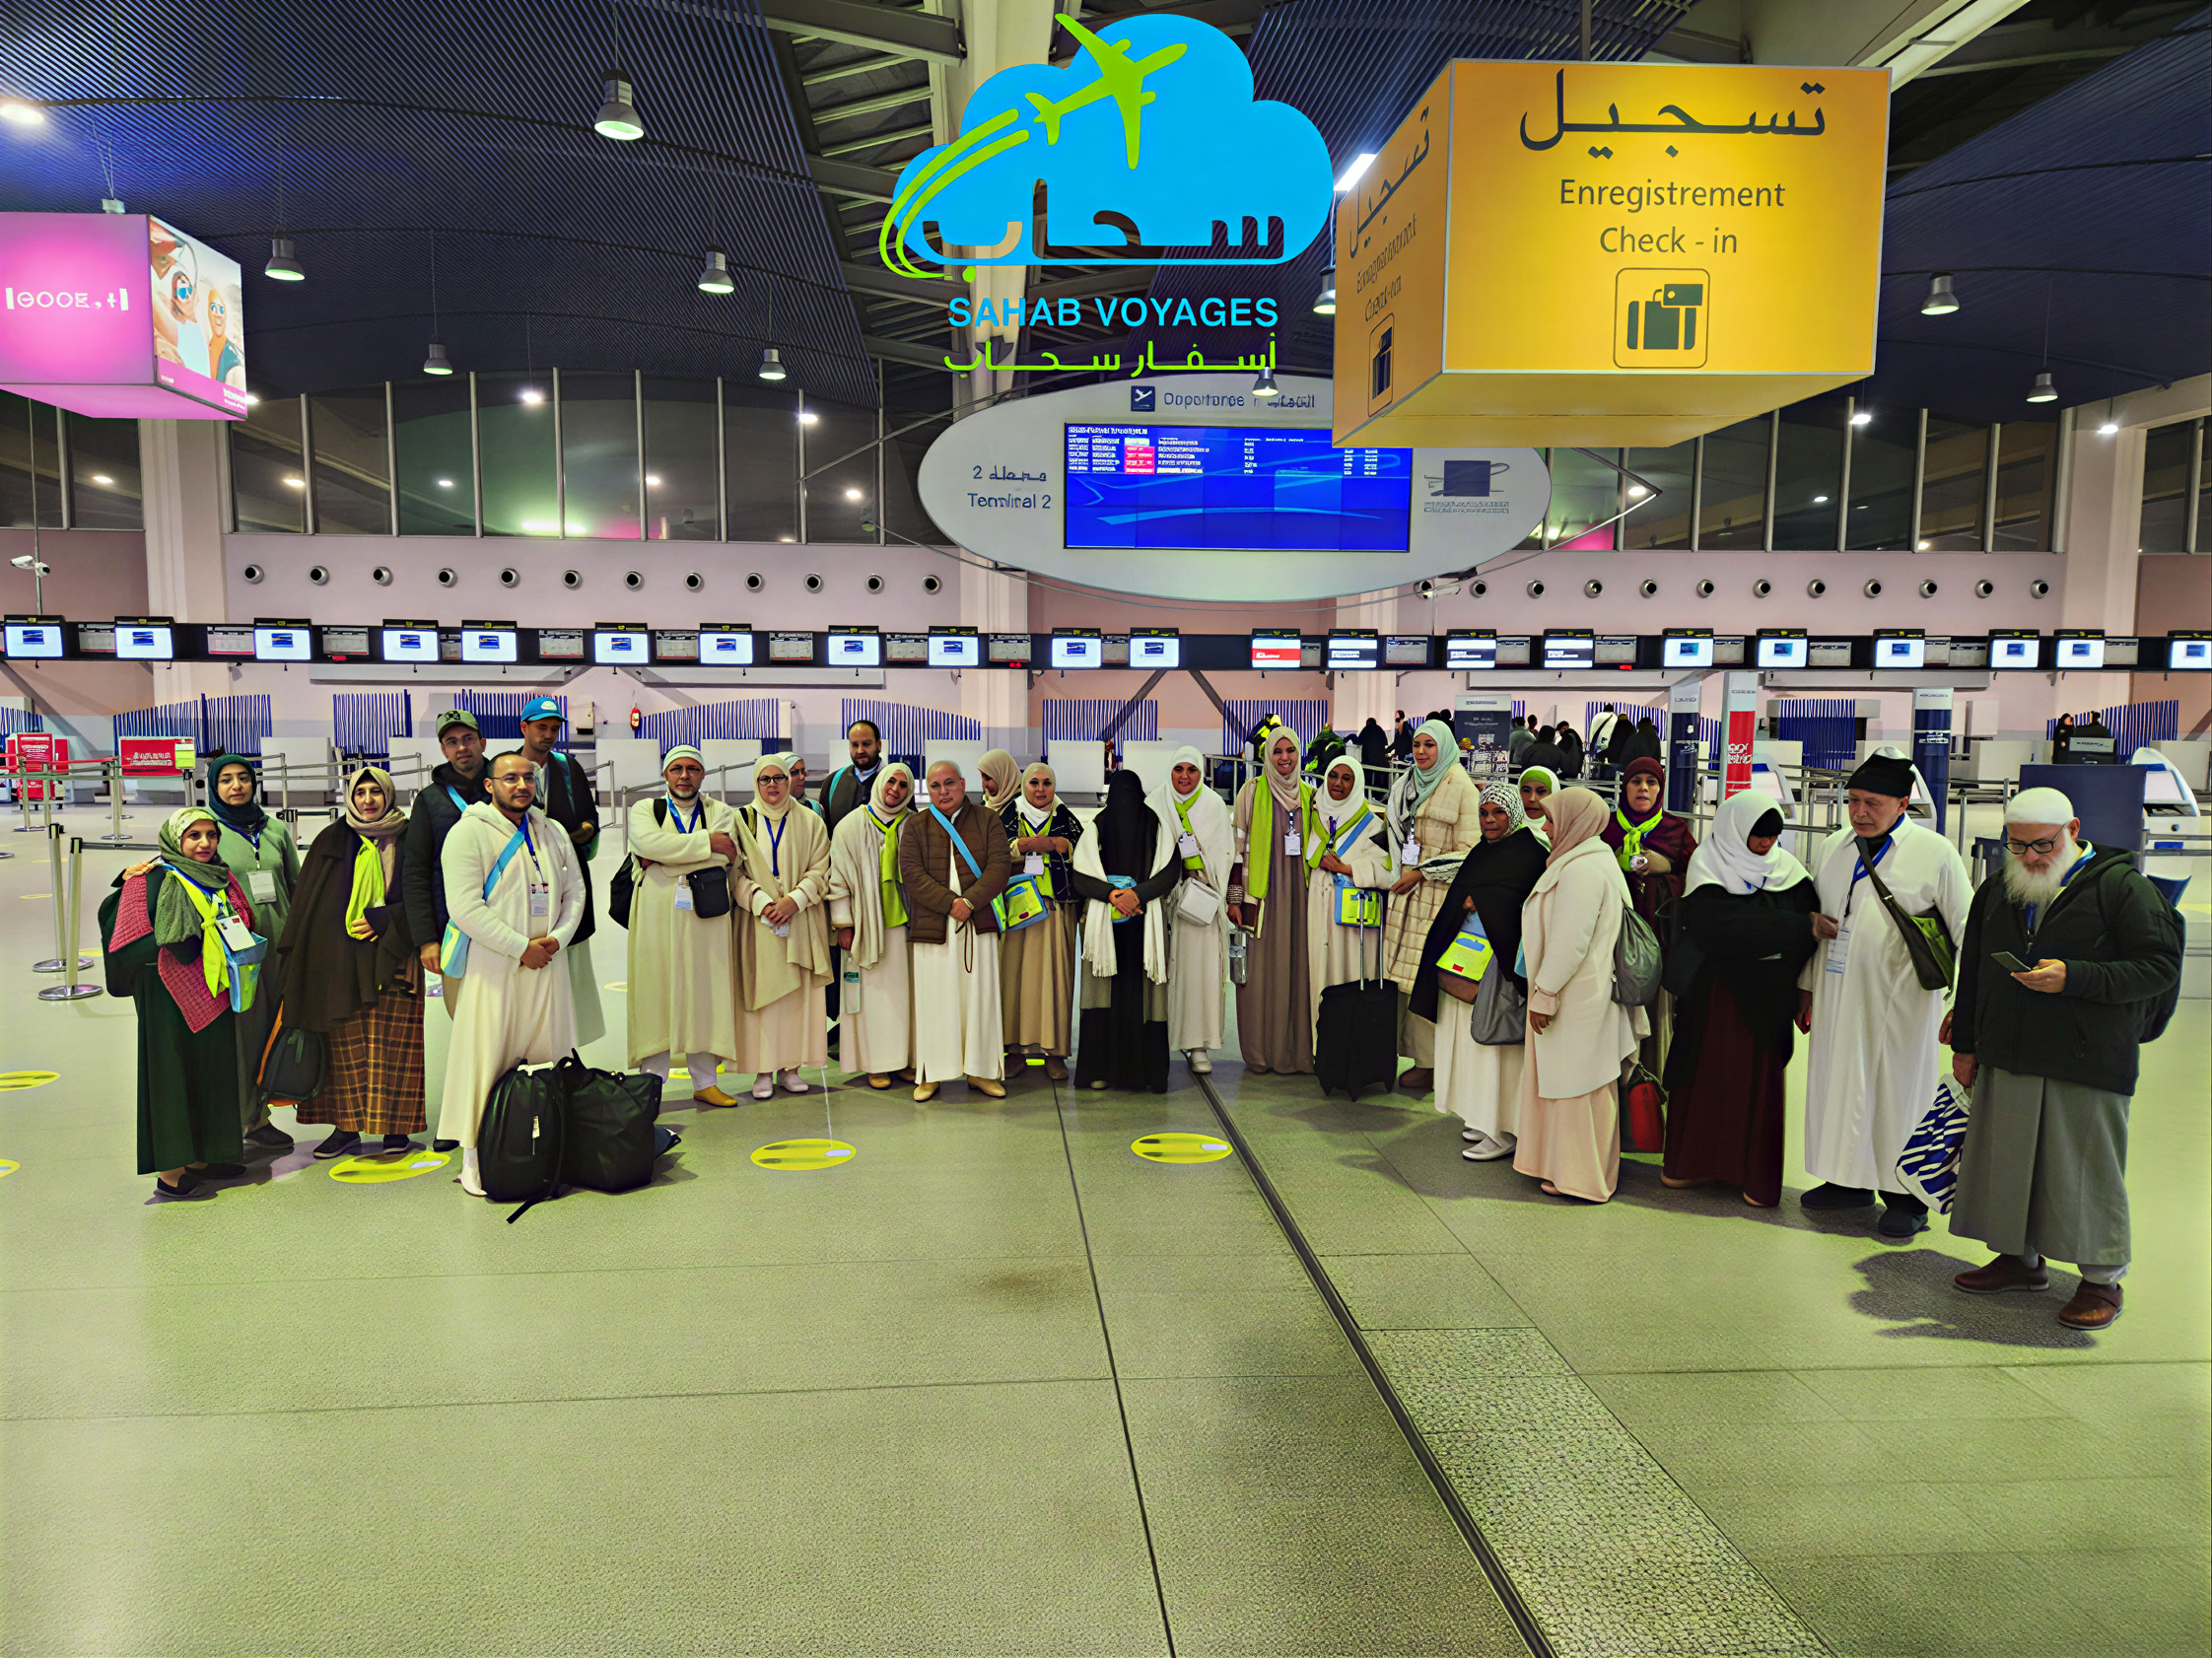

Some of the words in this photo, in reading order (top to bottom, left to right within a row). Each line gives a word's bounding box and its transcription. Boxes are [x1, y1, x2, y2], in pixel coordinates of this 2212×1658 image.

[1519, 68, 1826, 159] تسجيل
[1560, 179, 1786, 213] Enregistrement
[1600, 227, 1687, 253] Check
[1713, 226, 1739, 253] in
[1041, 494, 1052, 510] 2
